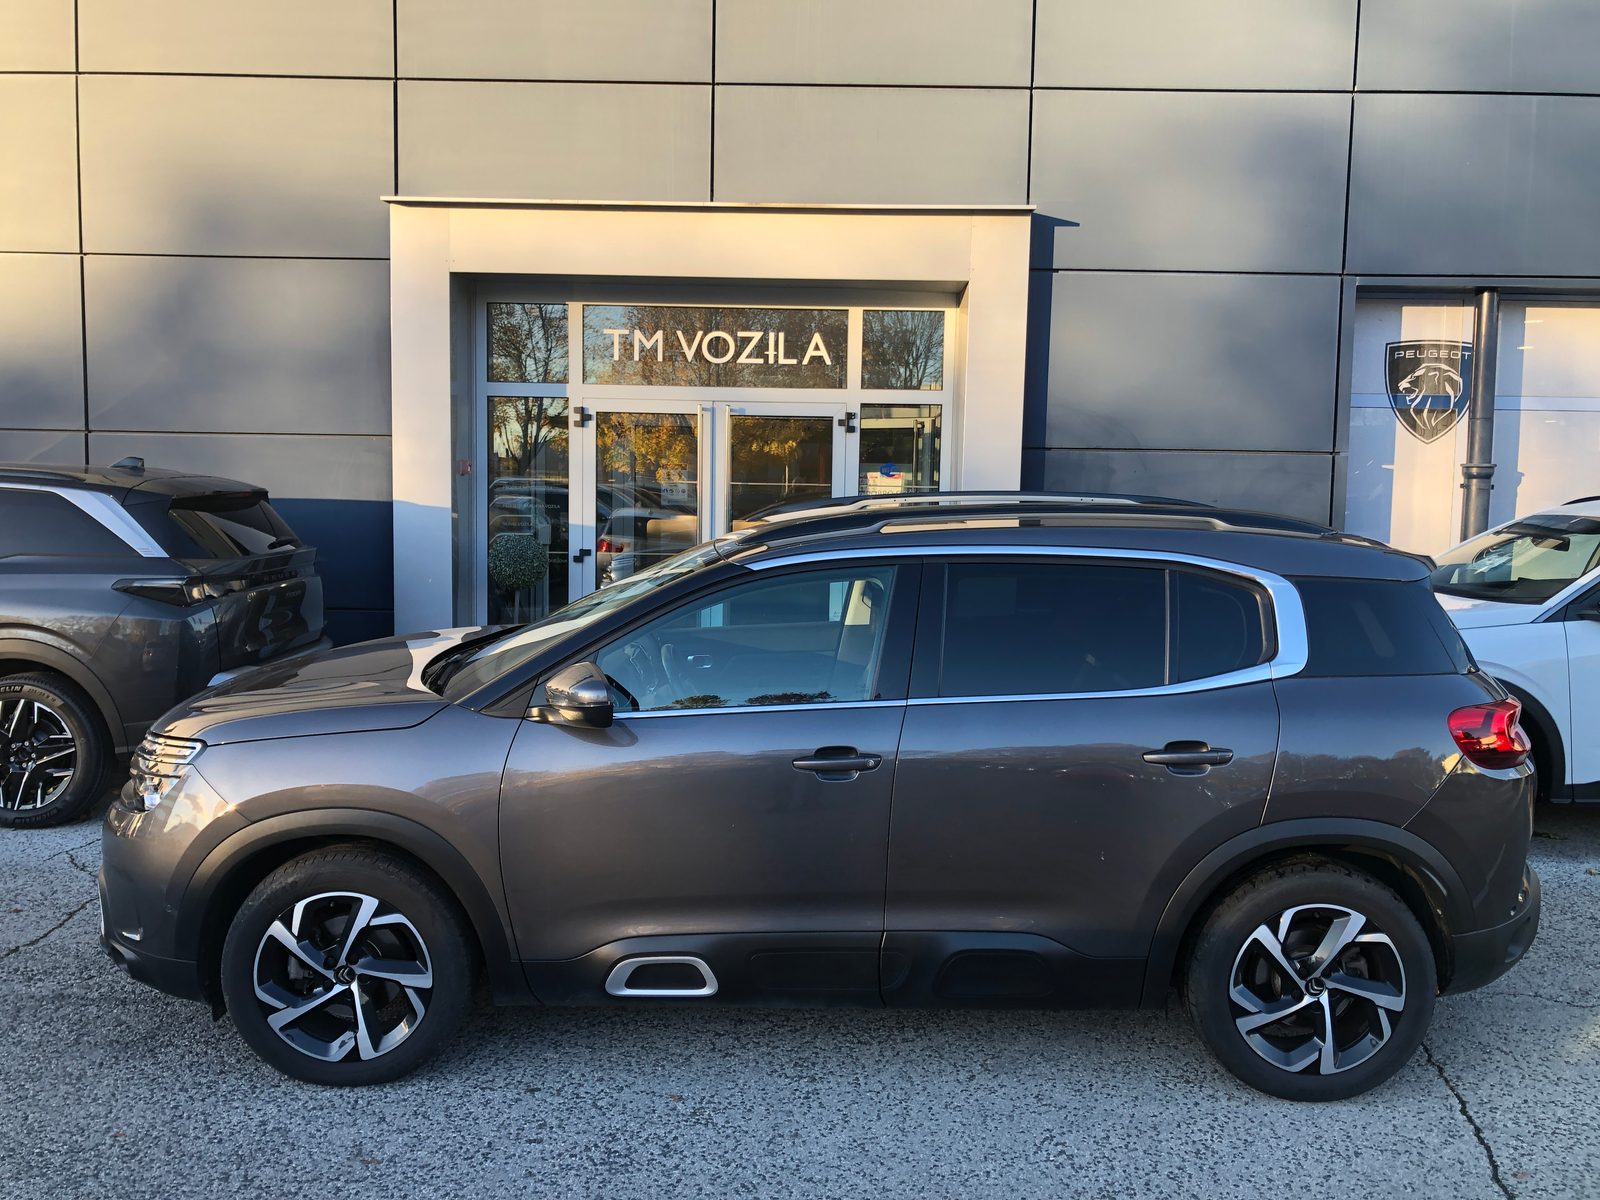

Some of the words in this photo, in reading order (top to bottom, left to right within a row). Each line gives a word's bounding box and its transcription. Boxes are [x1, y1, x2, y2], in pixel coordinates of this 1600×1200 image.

[603, 329, 663, 362] TM
[676, 330, 832, 365] VOZILA
[1395, 350, 1471, 360] PEUGEOT
